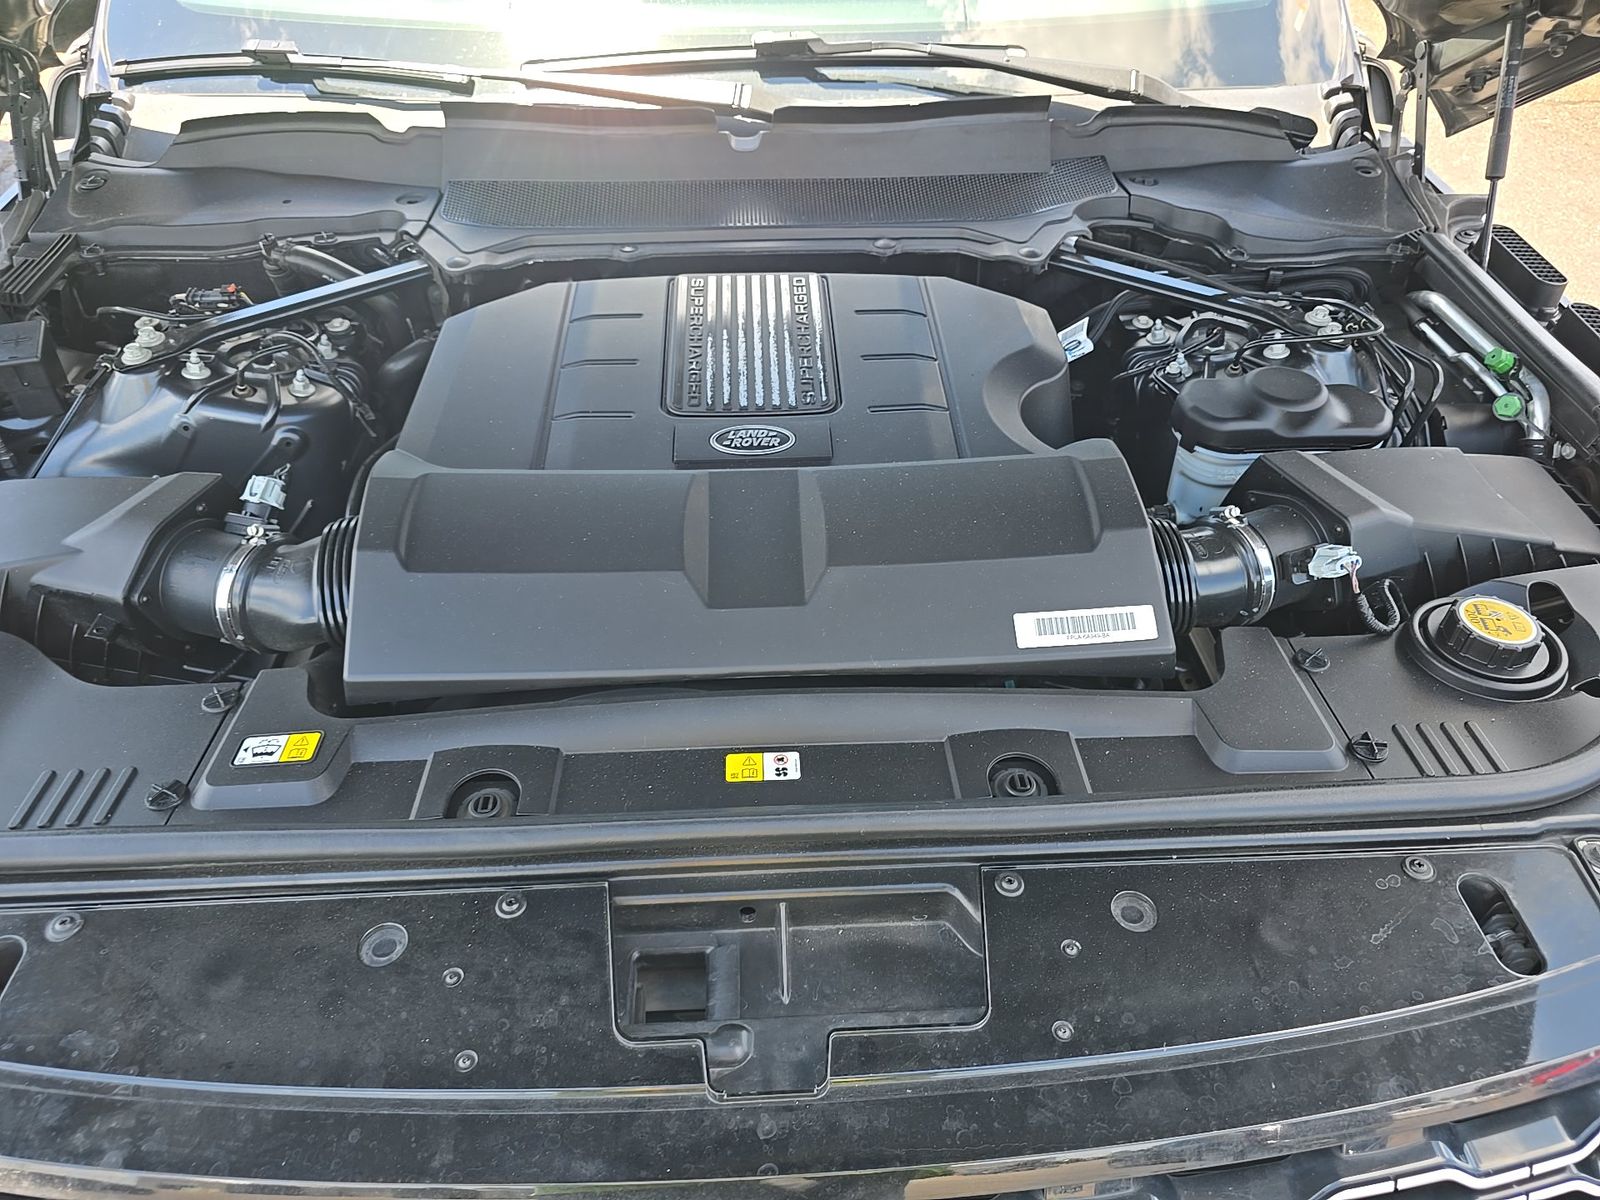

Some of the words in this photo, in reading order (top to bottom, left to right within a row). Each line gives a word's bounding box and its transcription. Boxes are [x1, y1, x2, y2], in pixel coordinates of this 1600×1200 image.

[688, 278, 704, 407] SUPERCHARGED
[792, 276, 816, 406] SUPERCHARGED
[728, 429, 769, 439] LAND
[730, 437, 781, 448] ROVER
